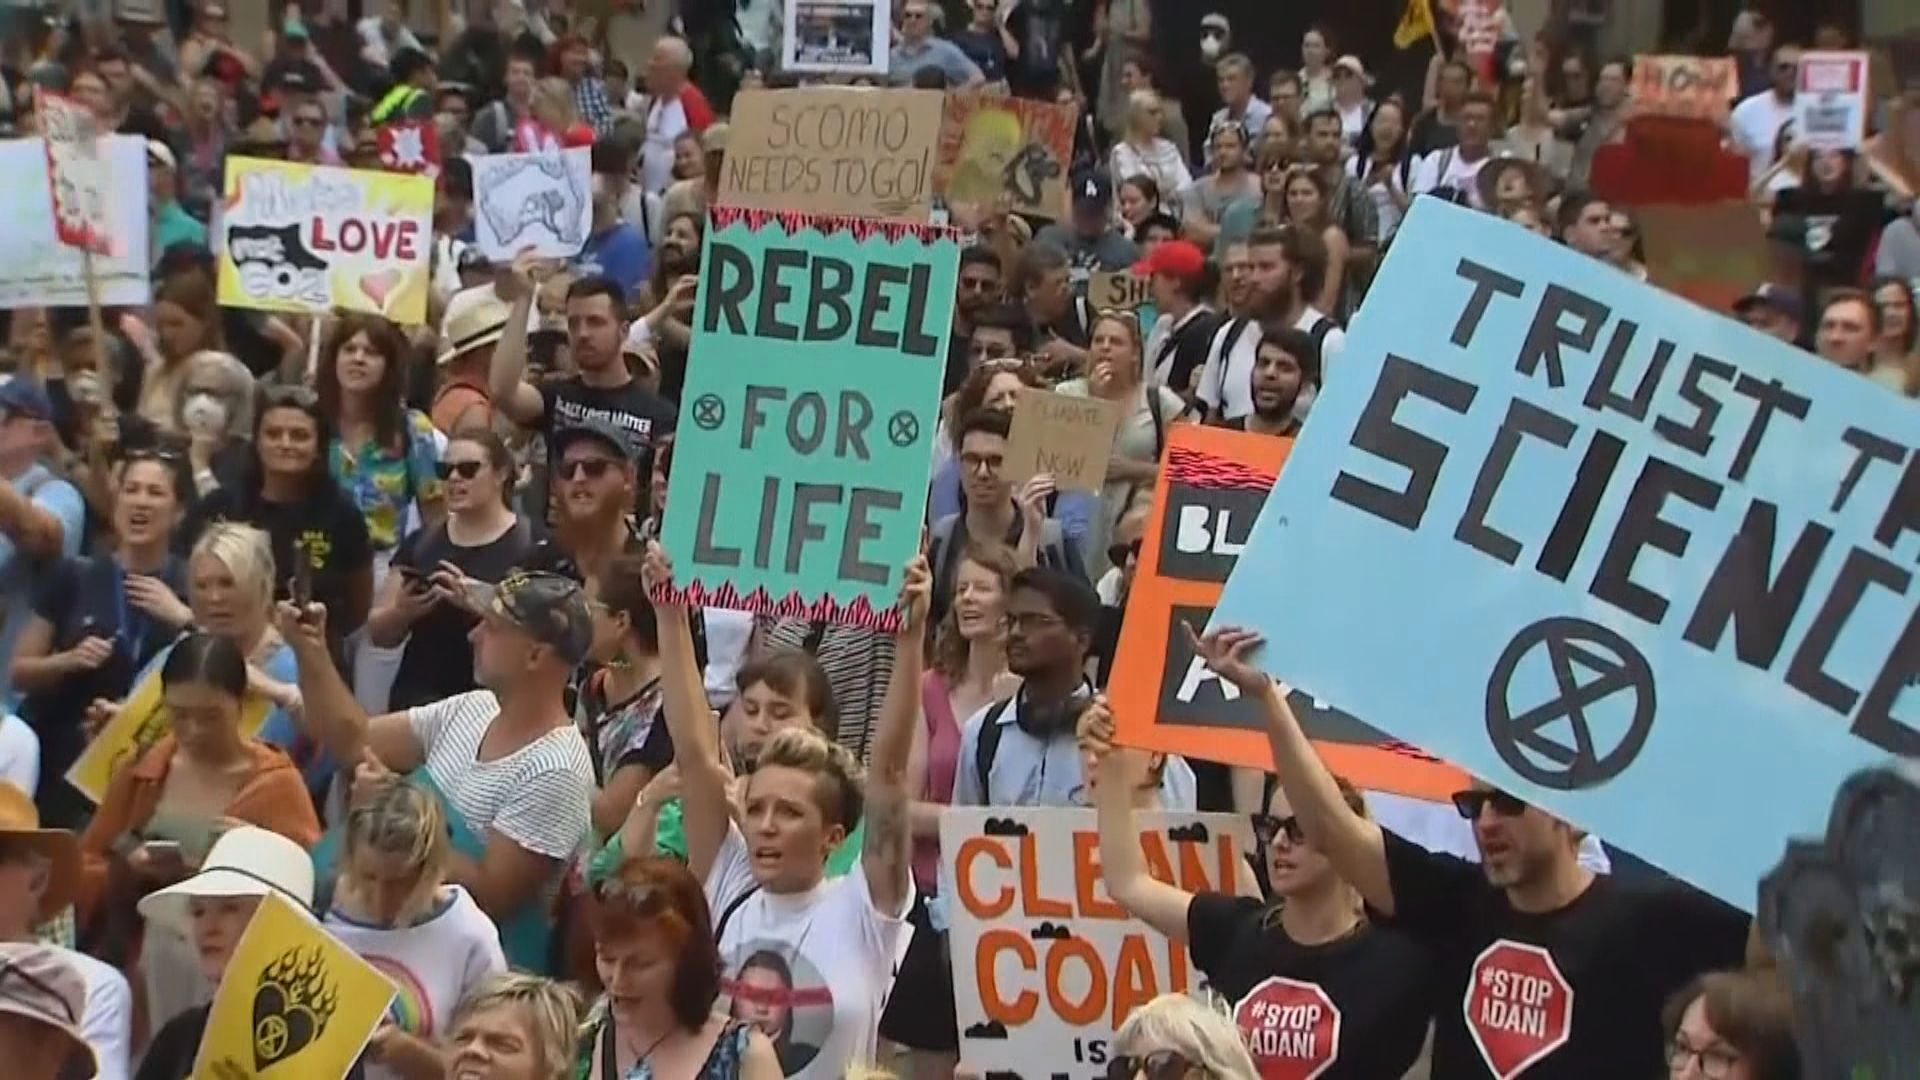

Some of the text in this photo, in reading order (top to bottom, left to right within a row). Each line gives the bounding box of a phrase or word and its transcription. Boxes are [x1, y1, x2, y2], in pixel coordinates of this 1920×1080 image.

[767, 103, 909, 151] SCOMO
[729, 154, 822, 194] NEEDS
[311, 216, 419, 260] LOVE
[703, 242, 938, 357] REBEL
[1456, 258, 1812, 482] TRUST
[740, 384, 874, 461] FOR
[692, 472, 903, 586] LIFE
[1481, 967, 1555, 1007] #STOP
[1252, 1000, 1322, 1031] #STOP
[1481, 998, 1548, 1039] ADANI
[1073, 1037, 1108, 1064] IS
[1249, 1026, 1316, 1059] ADANI
